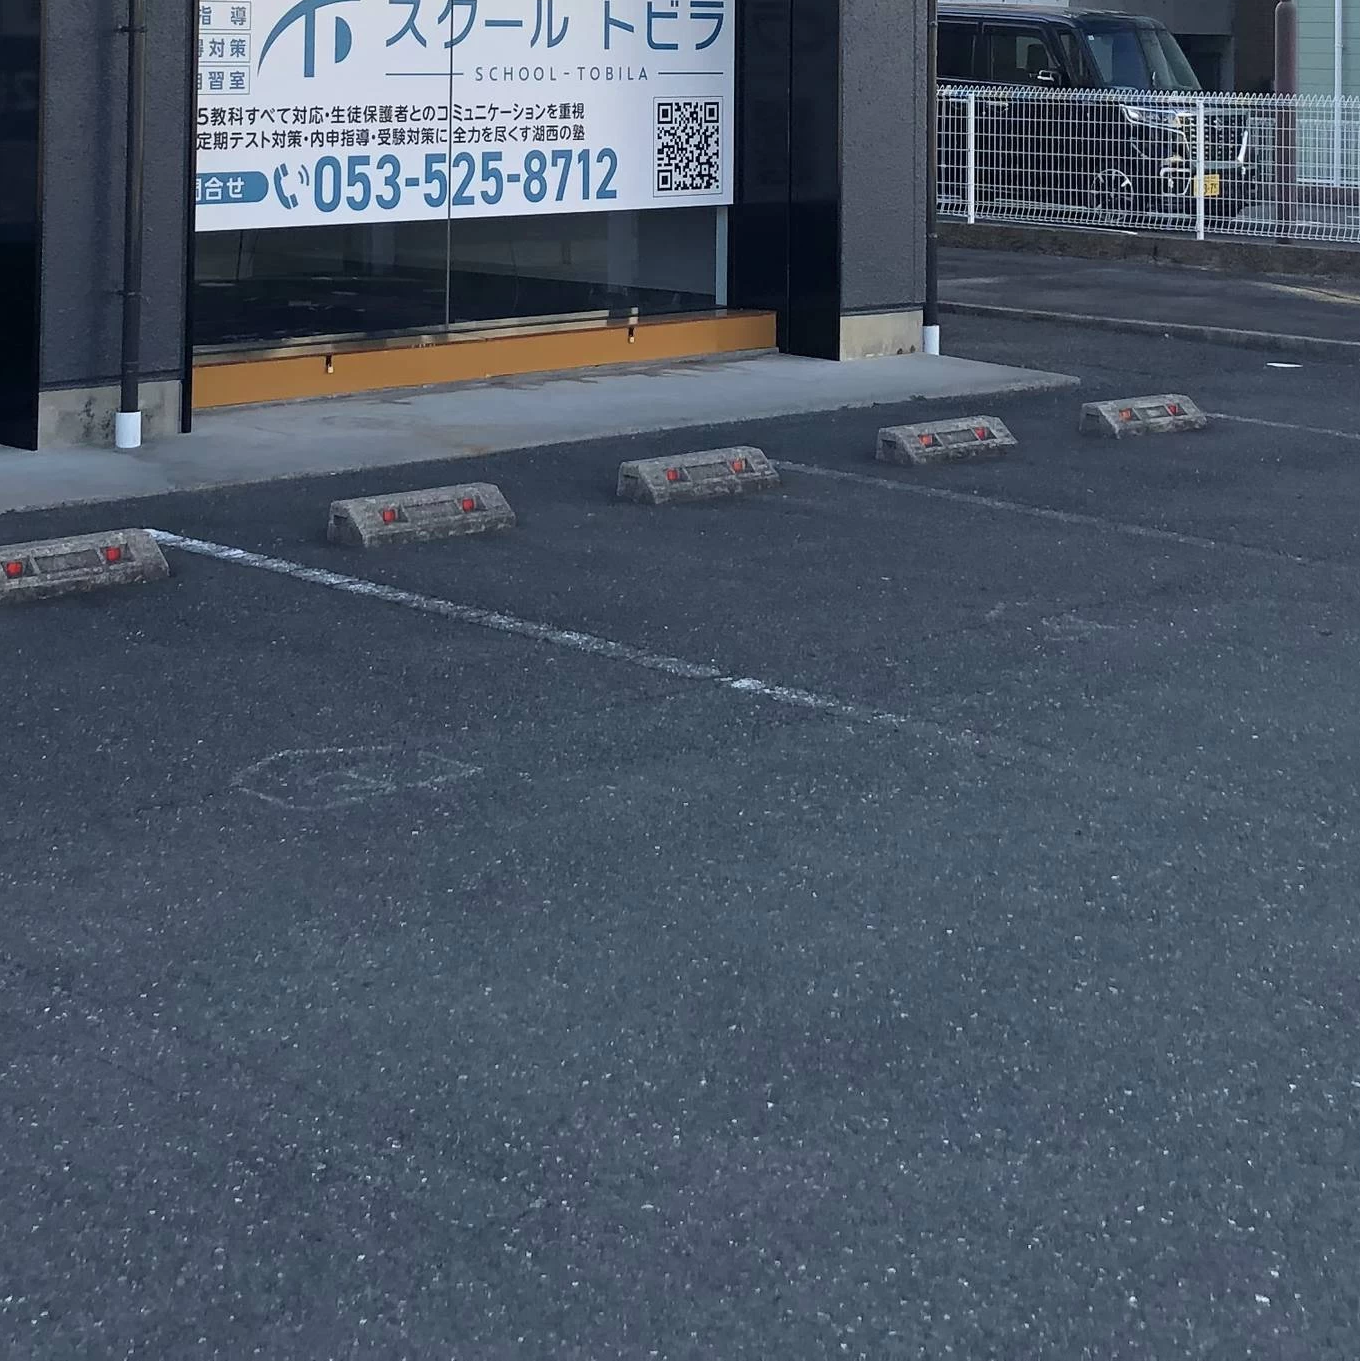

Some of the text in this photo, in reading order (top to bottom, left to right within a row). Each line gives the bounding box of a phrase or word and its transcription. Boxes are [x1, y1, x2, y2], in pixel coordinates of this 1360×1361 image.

[603, 0, 725, 52] トビラ
[474, 65, 649, 82] SCHOOL-TOBILA
[314, 147, 618, 213] 053-525-8712
